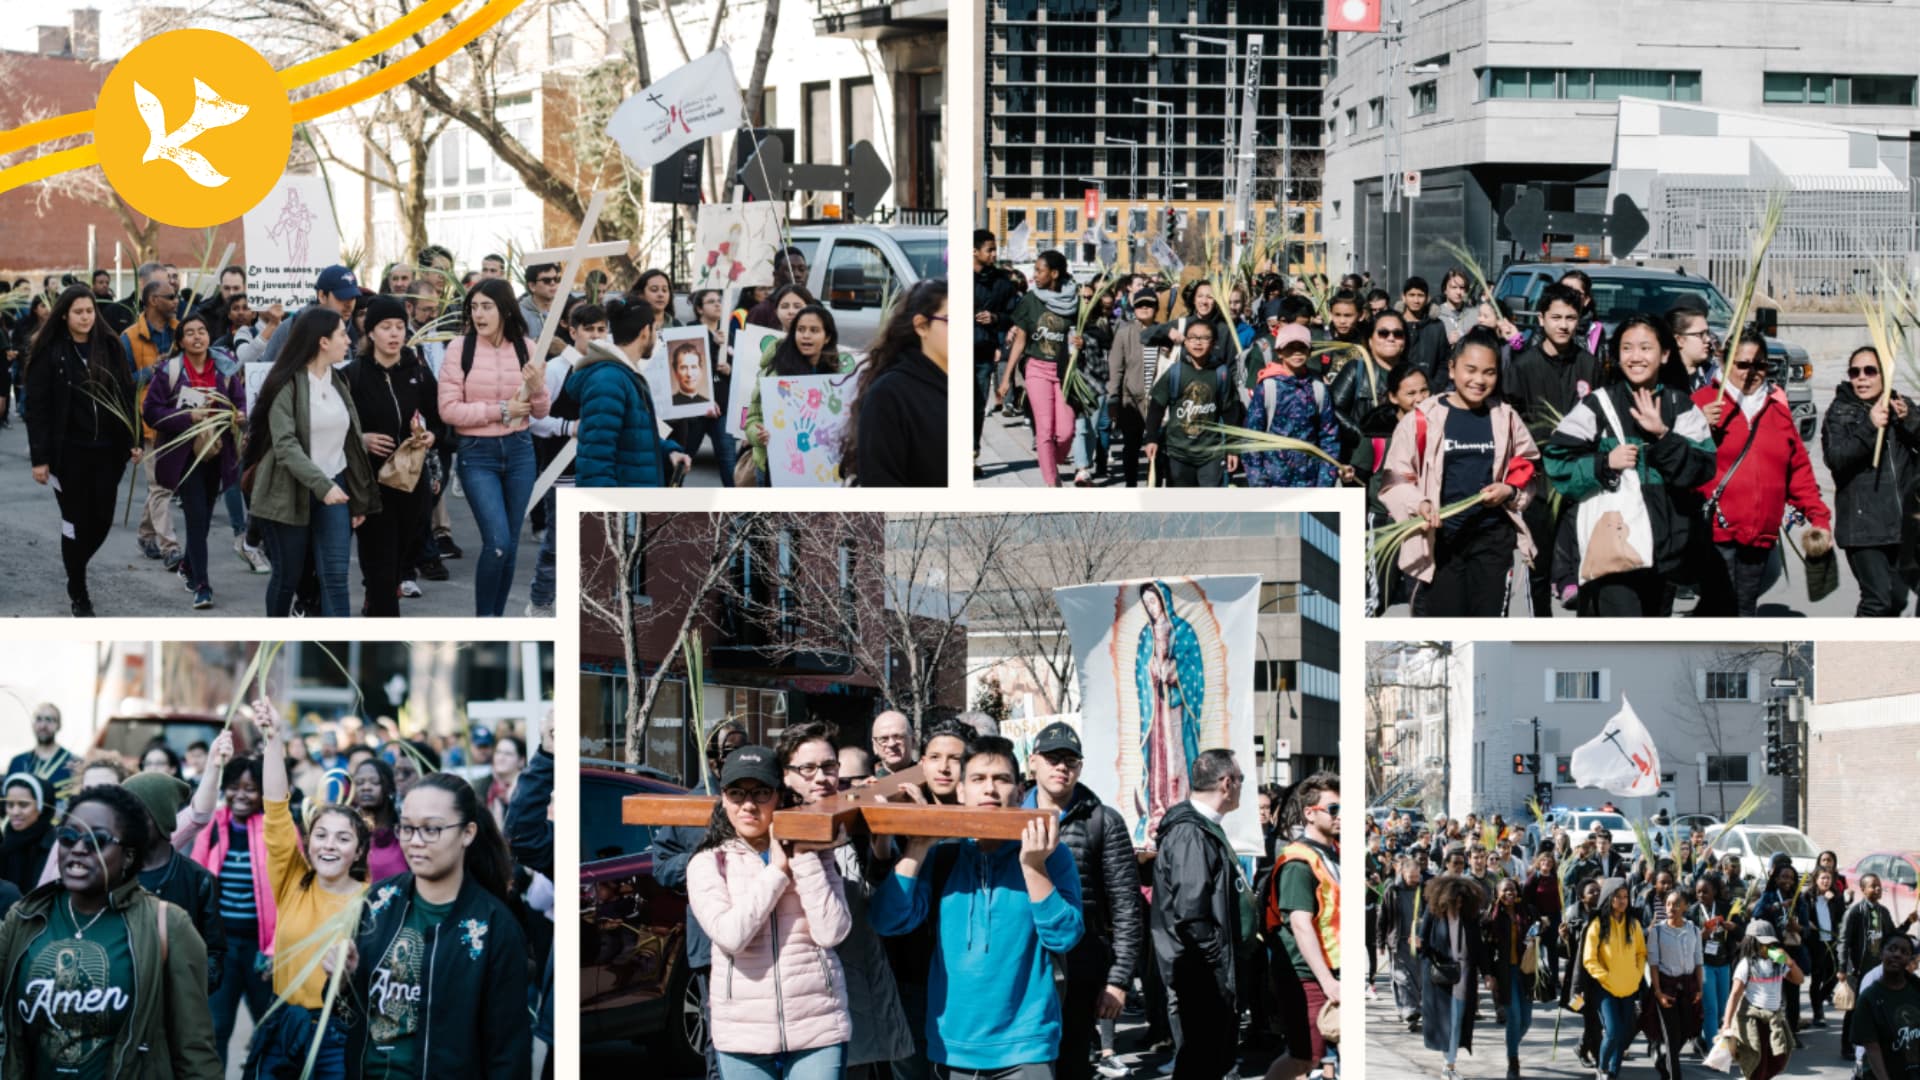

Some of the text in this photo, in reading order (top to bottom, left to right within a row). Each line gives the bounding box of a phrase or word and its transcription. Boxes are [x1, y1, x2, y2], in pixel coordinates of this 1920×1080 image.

[283, 266, 312, 274] manos
[248, 281, 259, 289] mi
[1177, 399, 1216, 422] Amen
[1444, 438, 1495, 454] Champi
[369, 967, 421, 1015] Ame
[18, 978, 129, 1030] Amen
